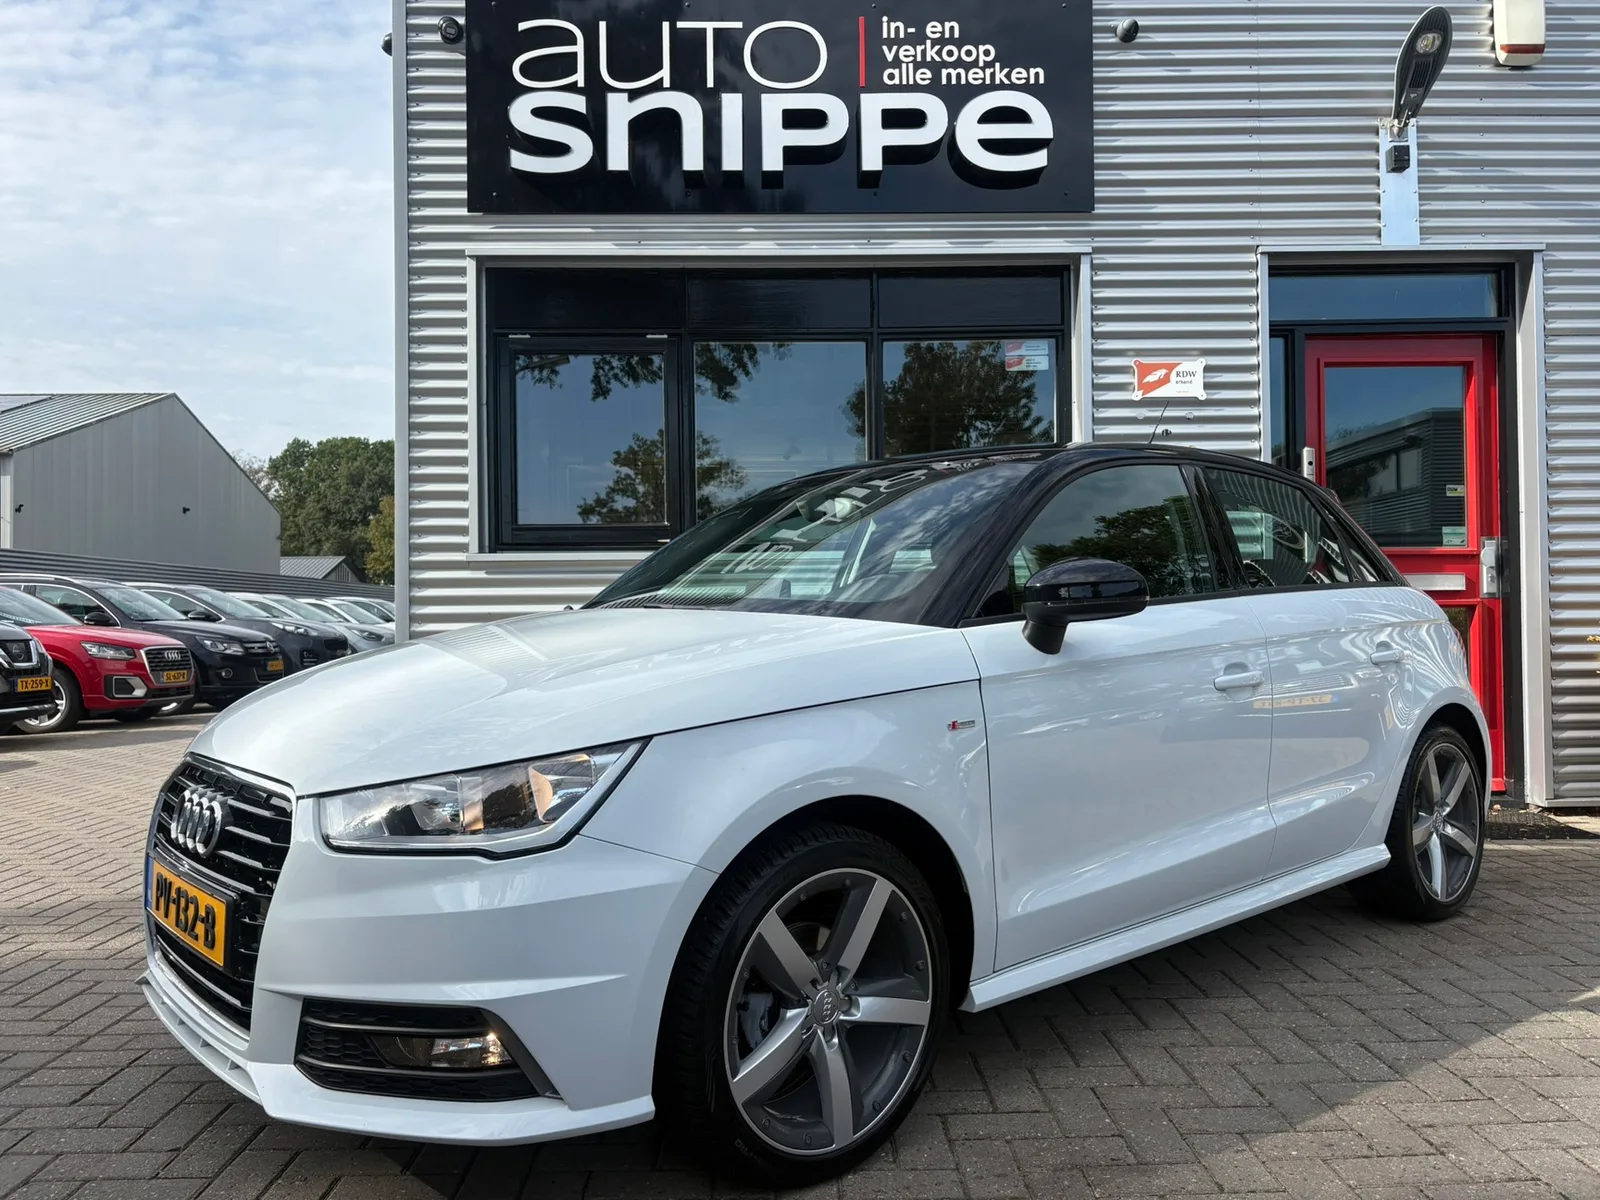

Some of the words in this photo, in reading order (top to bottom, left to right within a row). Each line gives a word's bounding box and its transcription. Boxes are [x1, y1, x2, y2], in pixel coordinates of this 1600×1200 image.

[882, 16, 916, 39] in-
[926, 21, 960, 39] en
[882, 42, 996, 66] verkoop
[883, 62, 933, 86] alle
[941, 62, 1045, 86] merken
[1175, 370, 1198, 378] RDW
[20, 678, 50, 690] TX-259-X
[155, 871, 216, 951] PV-132-B
